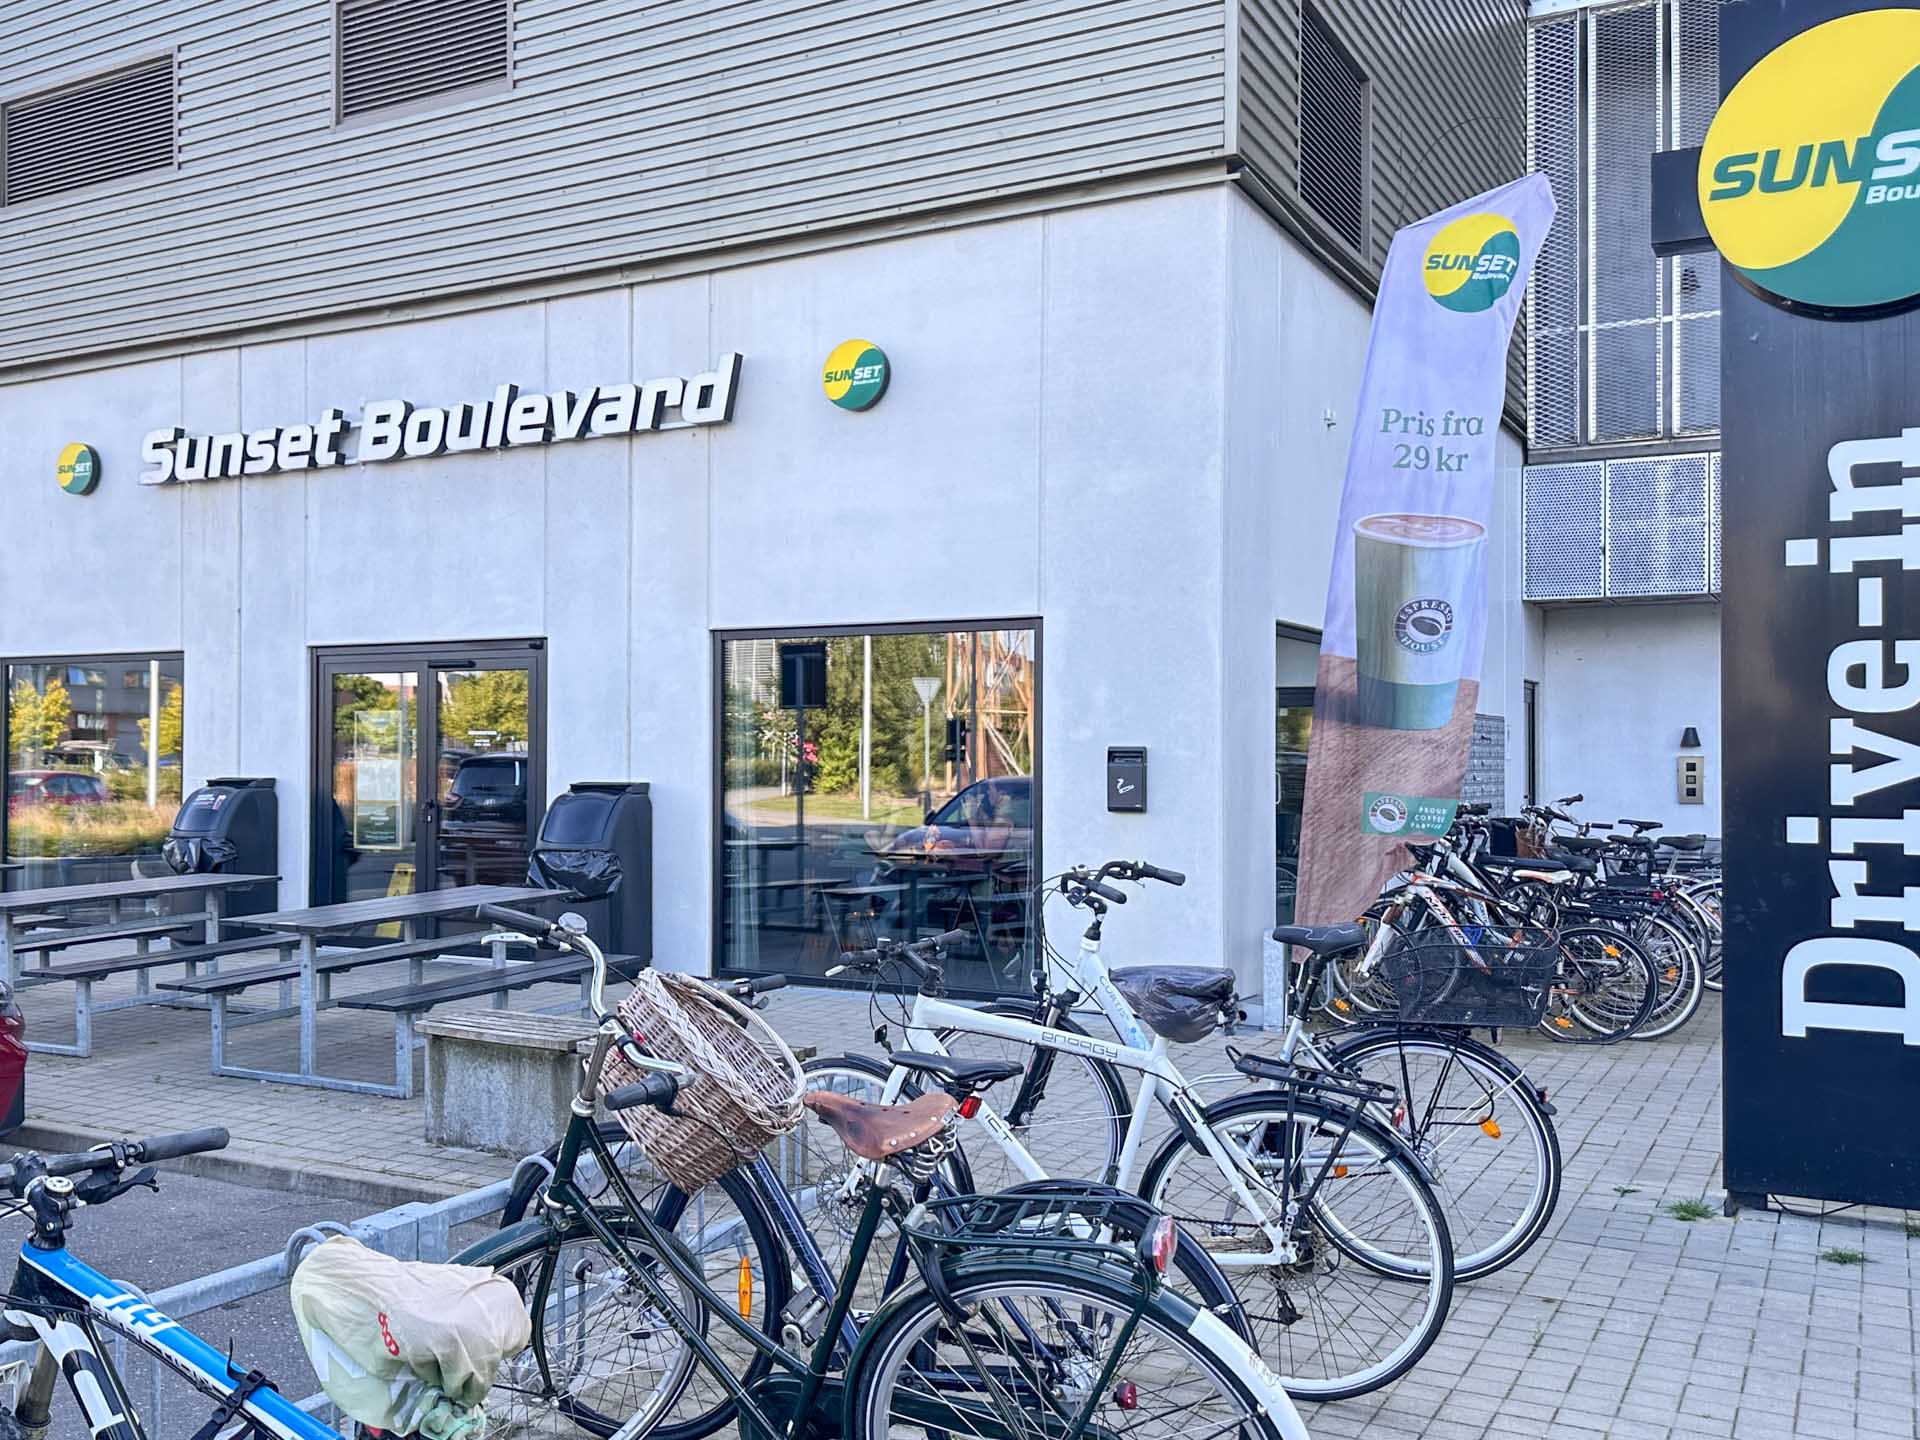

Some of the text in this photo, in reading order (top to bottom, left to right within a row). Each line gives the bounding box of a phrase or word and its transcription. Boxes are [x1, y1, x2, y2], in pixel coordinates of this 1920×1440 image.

[1708, 128, 1920, 202] SUNS
[1865, 184, 1920, 205] Bou
[1425, 253, 1518, 275] SUNSET
[823, 364, 883, 384] SUNSET
[139, 352, 743, 486] Sunset Boulevard
[1379, 407, 1485, 438] Pris fra
[1391, 442, 1470, 472] 29 kr
[1399, 600, 1453, 622] ESPRESSO
[1781, 427, 1920, 1046] Drive-in
